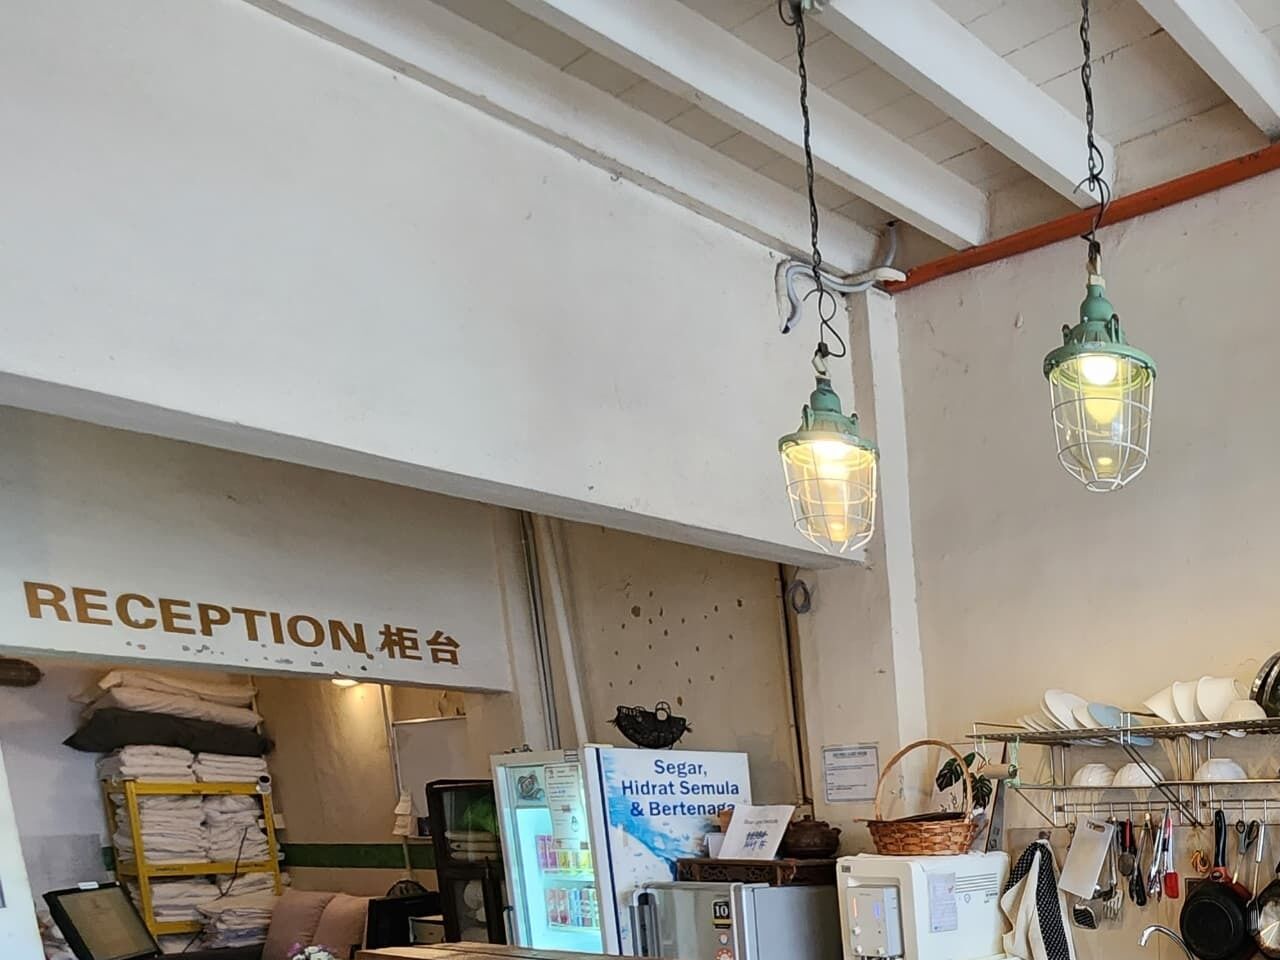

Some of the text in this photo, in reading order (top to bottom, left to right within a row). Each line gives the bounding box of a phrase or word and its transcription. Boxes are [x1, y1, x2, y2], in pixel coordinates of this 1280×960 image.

[23, 581, 461, 666] RECEPTION 柜台
[654, 759, 708, 778] Segar,
[621, 780, 740, 796] Hidrat Semula
[630, 801, 645, 817] &
[715, 905, 729, 917] 10
